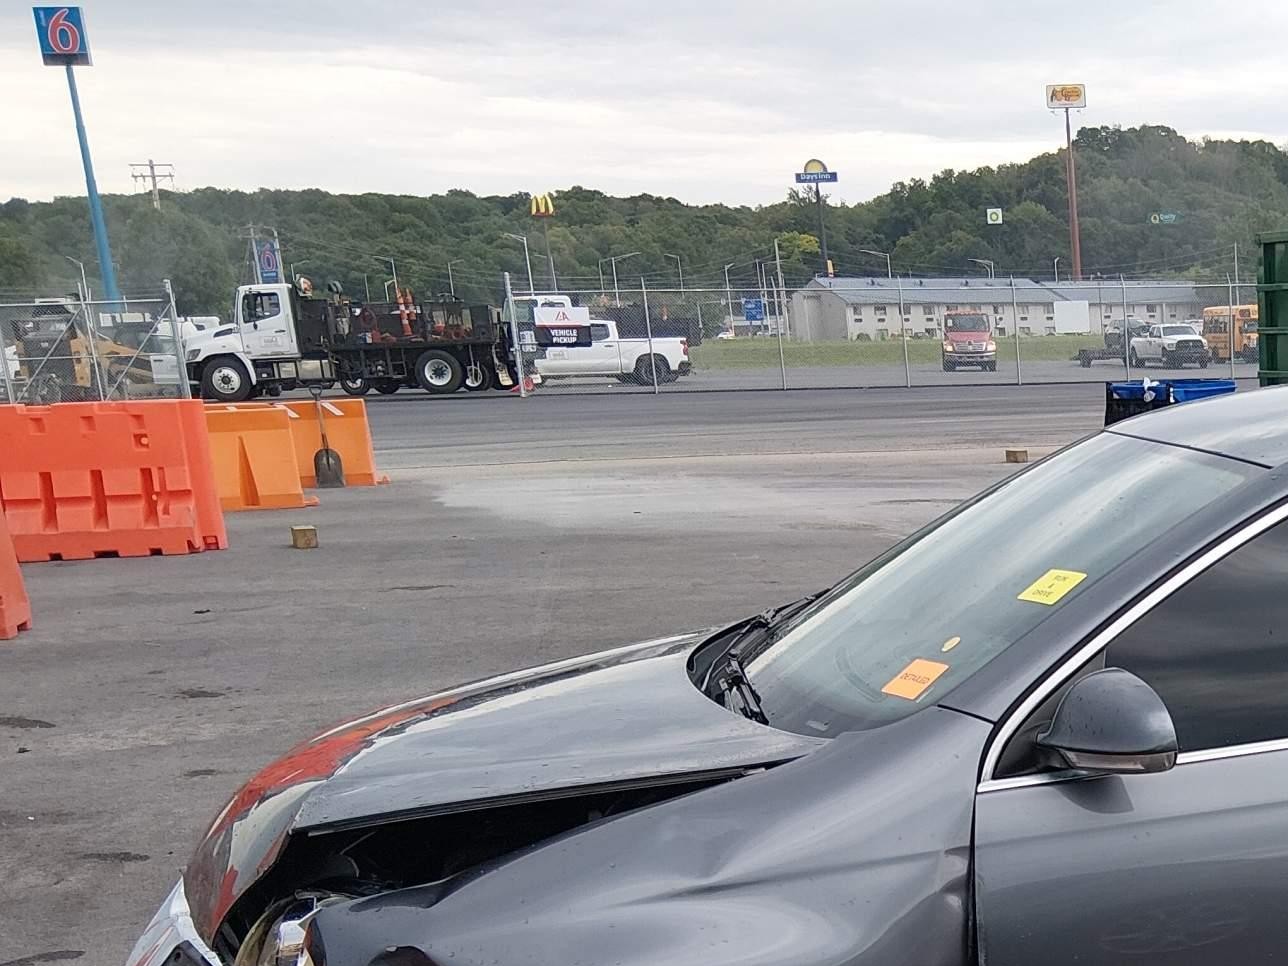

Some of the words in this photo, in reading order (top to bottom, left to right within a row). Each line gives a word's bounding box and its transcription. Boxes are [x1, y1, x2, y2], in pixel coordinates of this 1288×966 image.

[47, 8, 81, 54] 6
[549, 329, 578, 337] VEHICLE
[552, 336, 577, 344] PICKUP
